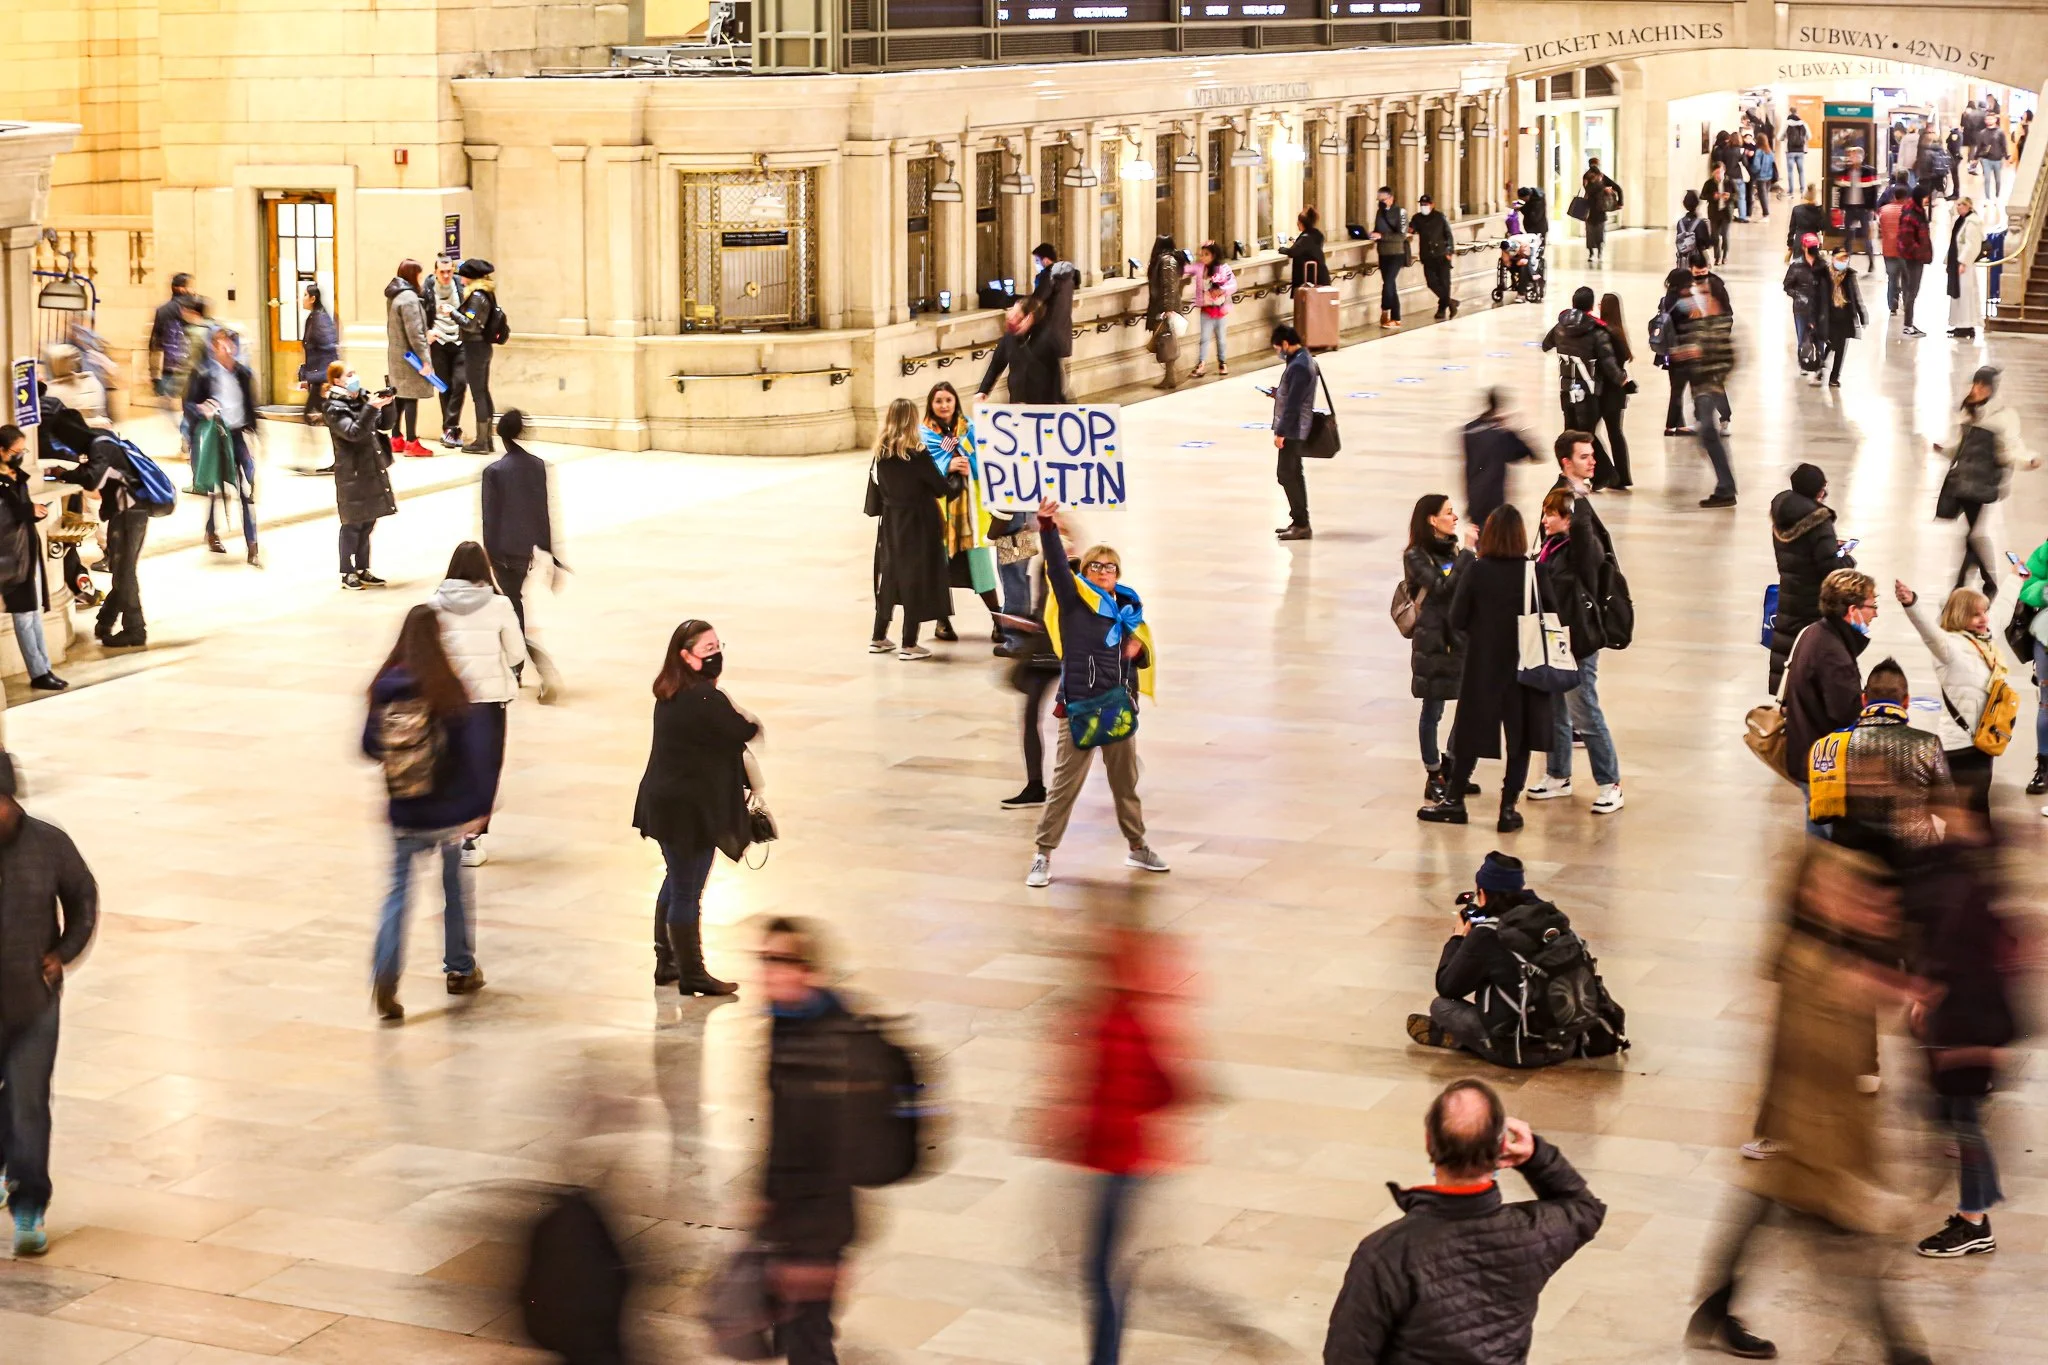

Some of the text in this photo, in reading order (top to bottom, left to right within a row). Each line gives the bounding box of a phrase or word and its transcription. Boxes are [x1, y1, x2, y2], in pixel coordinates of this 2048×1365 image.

[1523, 22, 1724, 62] TICKET MACHINES
[1799, 26, 1995, 71] SUBWAY 42ND ST
[1778, 61, 1853, 79] SUBWAY
[992, 410, 1116, 456] STOP
[983, 460, 1126, 505] PUTIN
